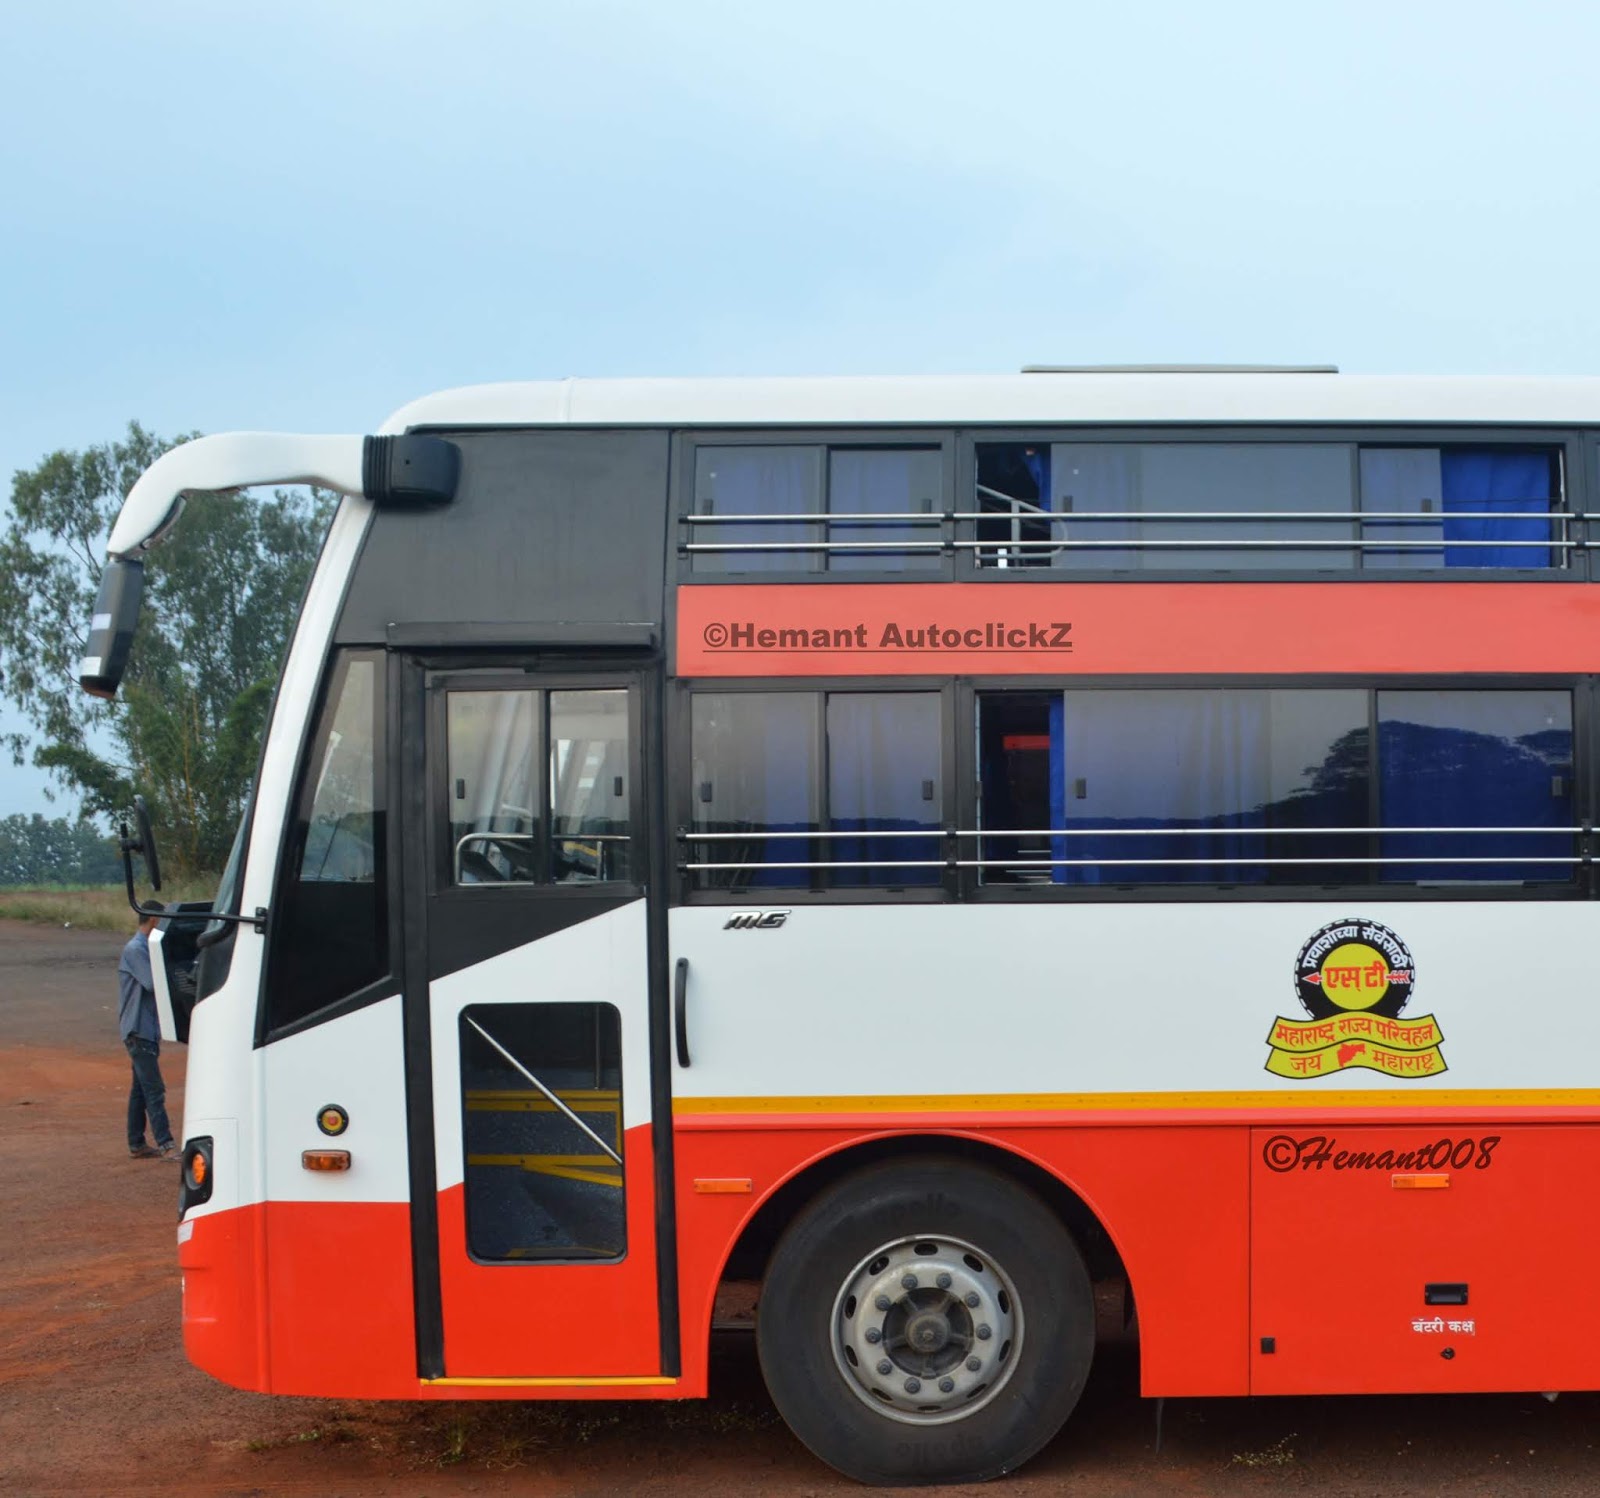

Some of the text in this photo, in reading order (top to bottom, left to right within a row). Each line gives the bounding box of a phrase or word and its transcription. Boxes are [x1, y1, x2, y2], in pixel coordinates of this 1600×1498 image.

[1276, 1017, 1434, 1047] महाराष्ट्र राज्य परिवहन
[1290, 1049, 1435, 1074] जय महाराष्ट्र
[1447, 1319, 1474, 1333] कक्ष
